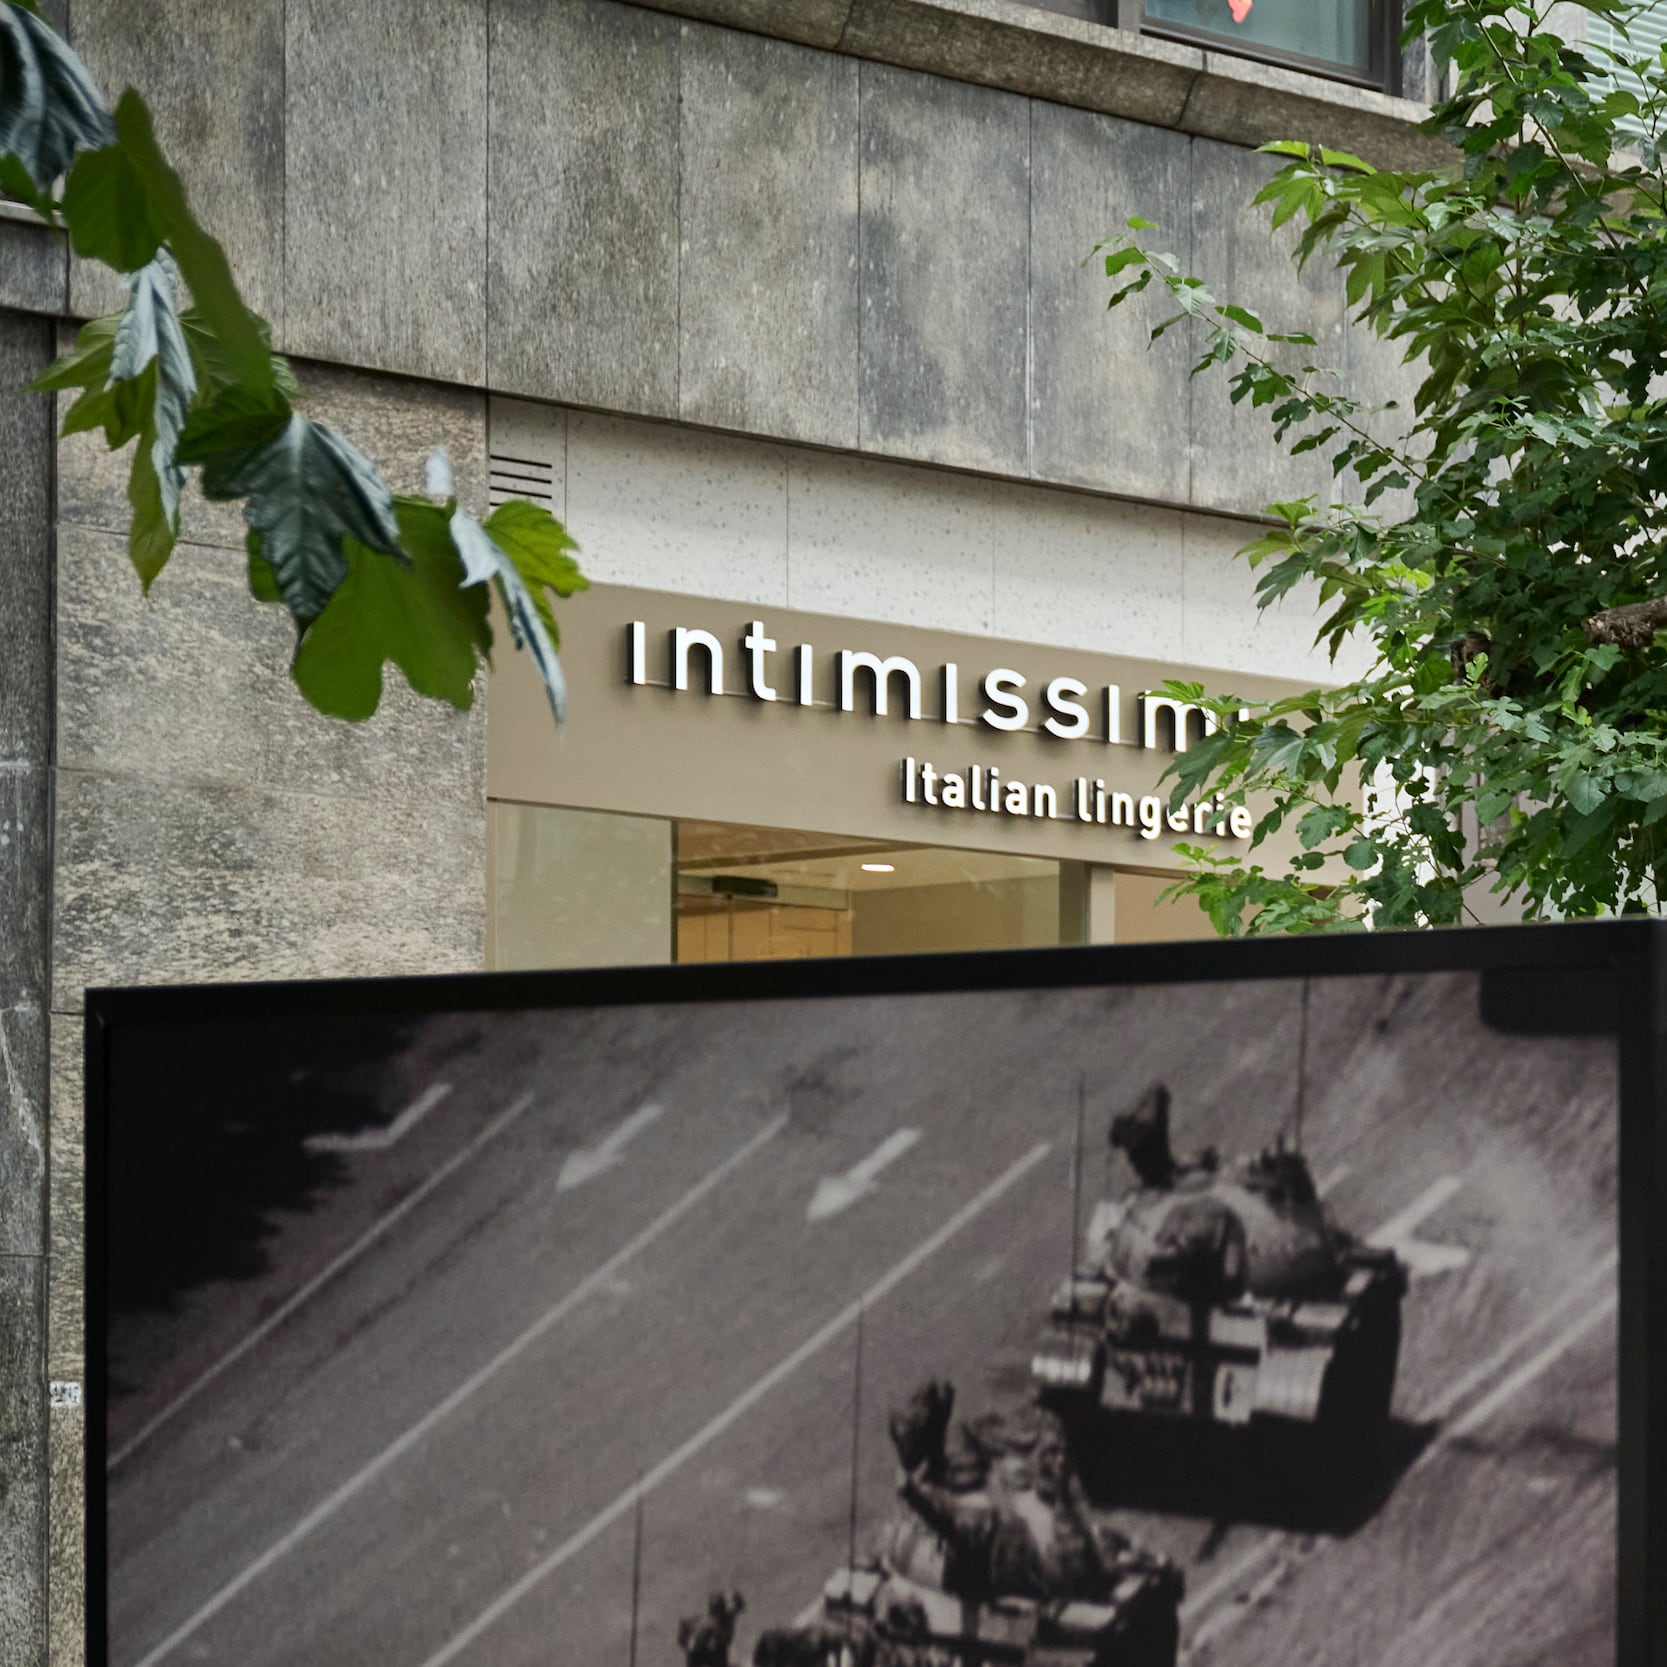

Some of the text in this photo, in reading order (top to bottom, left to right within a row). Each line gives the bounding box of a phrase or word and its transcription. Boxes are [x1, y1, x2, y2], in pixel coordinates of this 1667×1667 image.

[632, 619, 1250, 754] intimissim
[905, 756, 1253, 840] Italian lingerie
